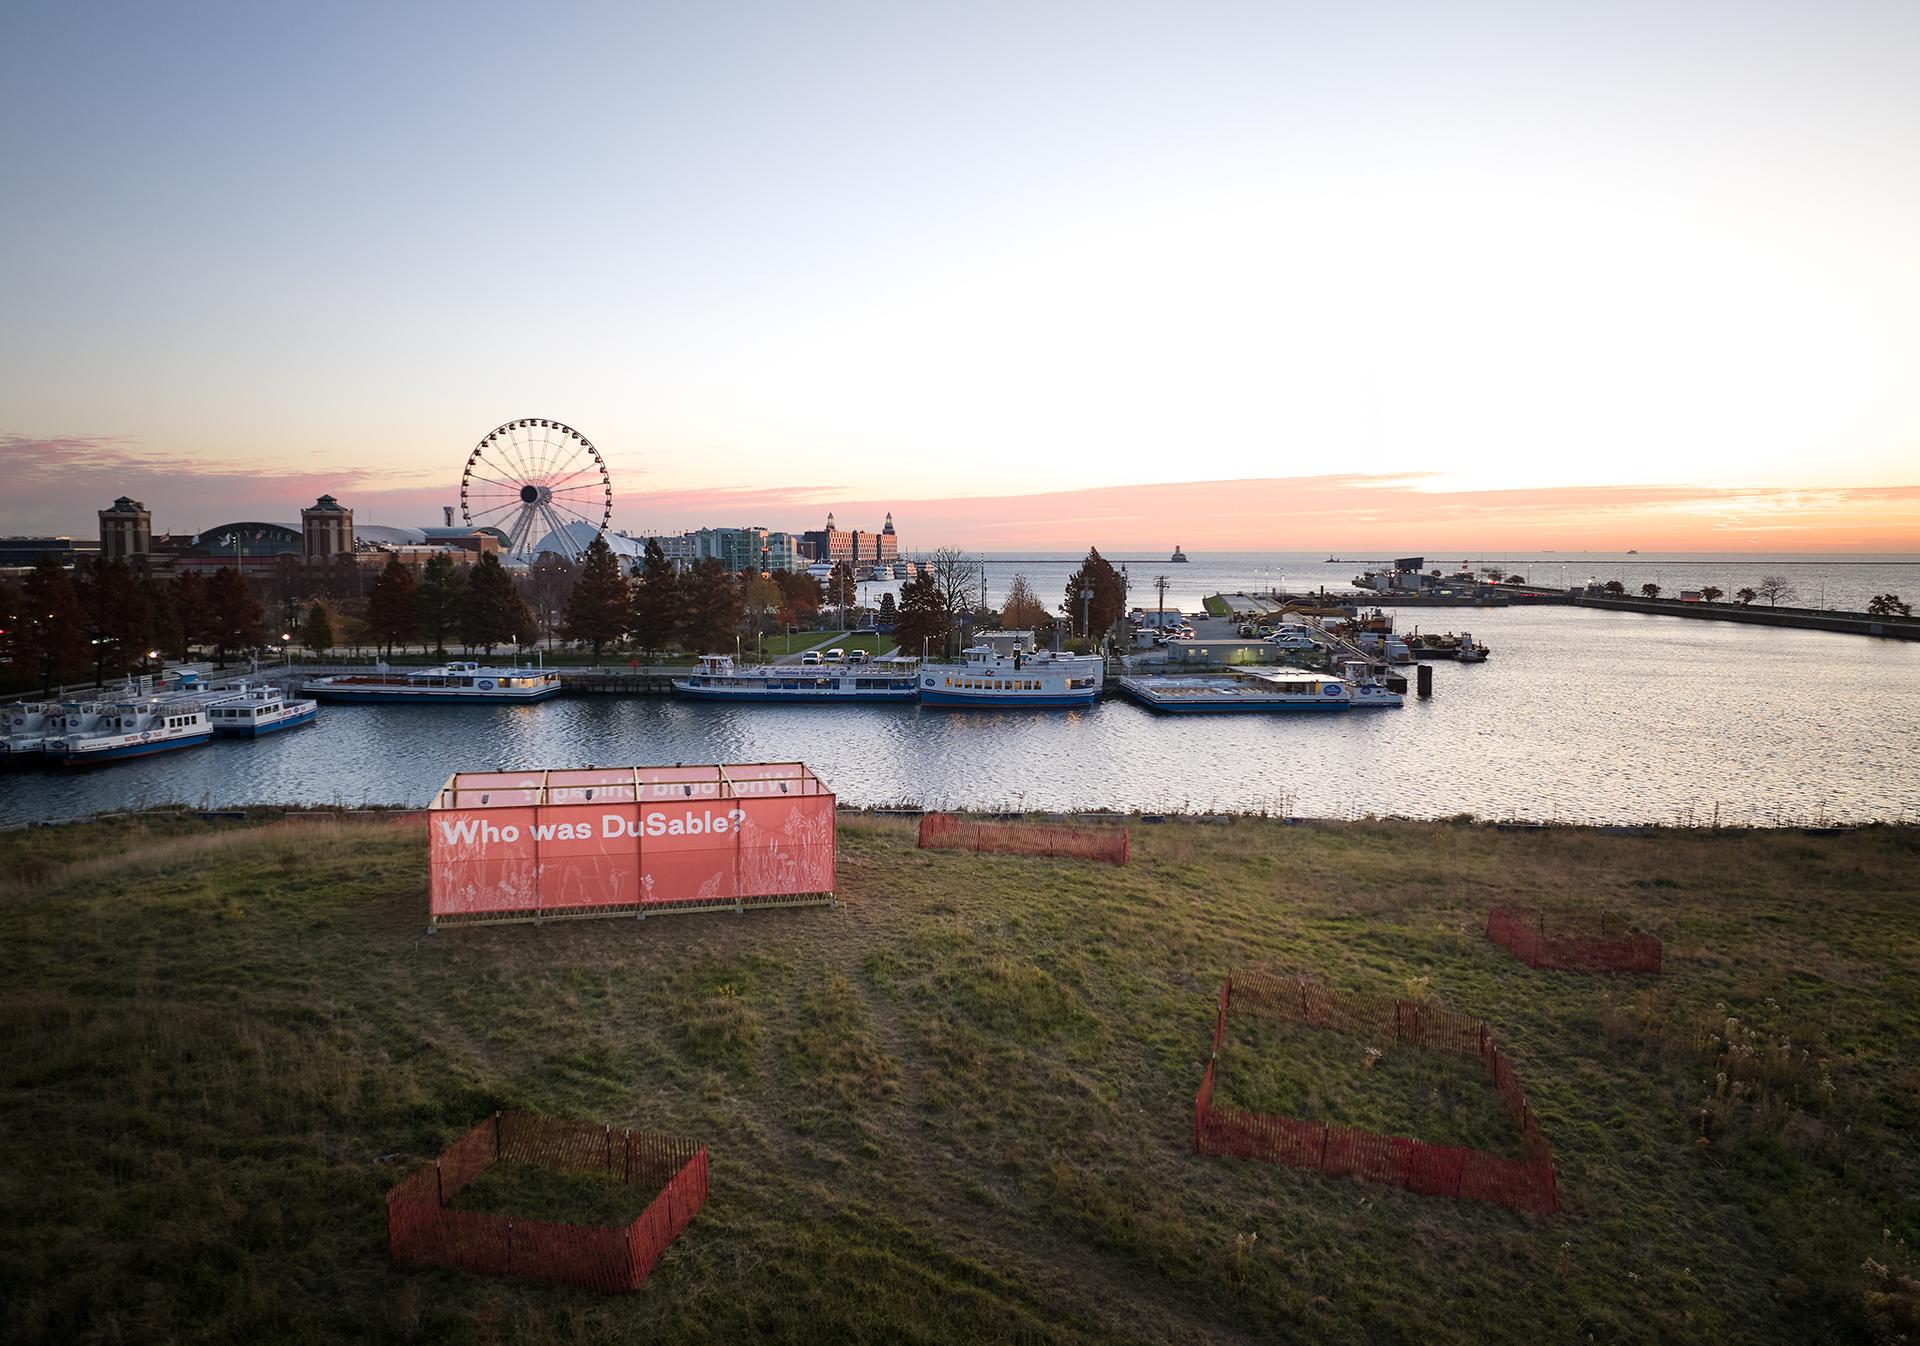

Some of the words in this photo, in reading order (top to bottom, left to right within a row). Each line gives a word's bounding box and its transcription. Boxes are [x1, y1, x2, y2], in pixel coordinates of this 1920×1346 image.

[441, 818, 520, 846] Who
[529, 822, 592, 841] was
[602, 808, 746, 839] DuSable?
